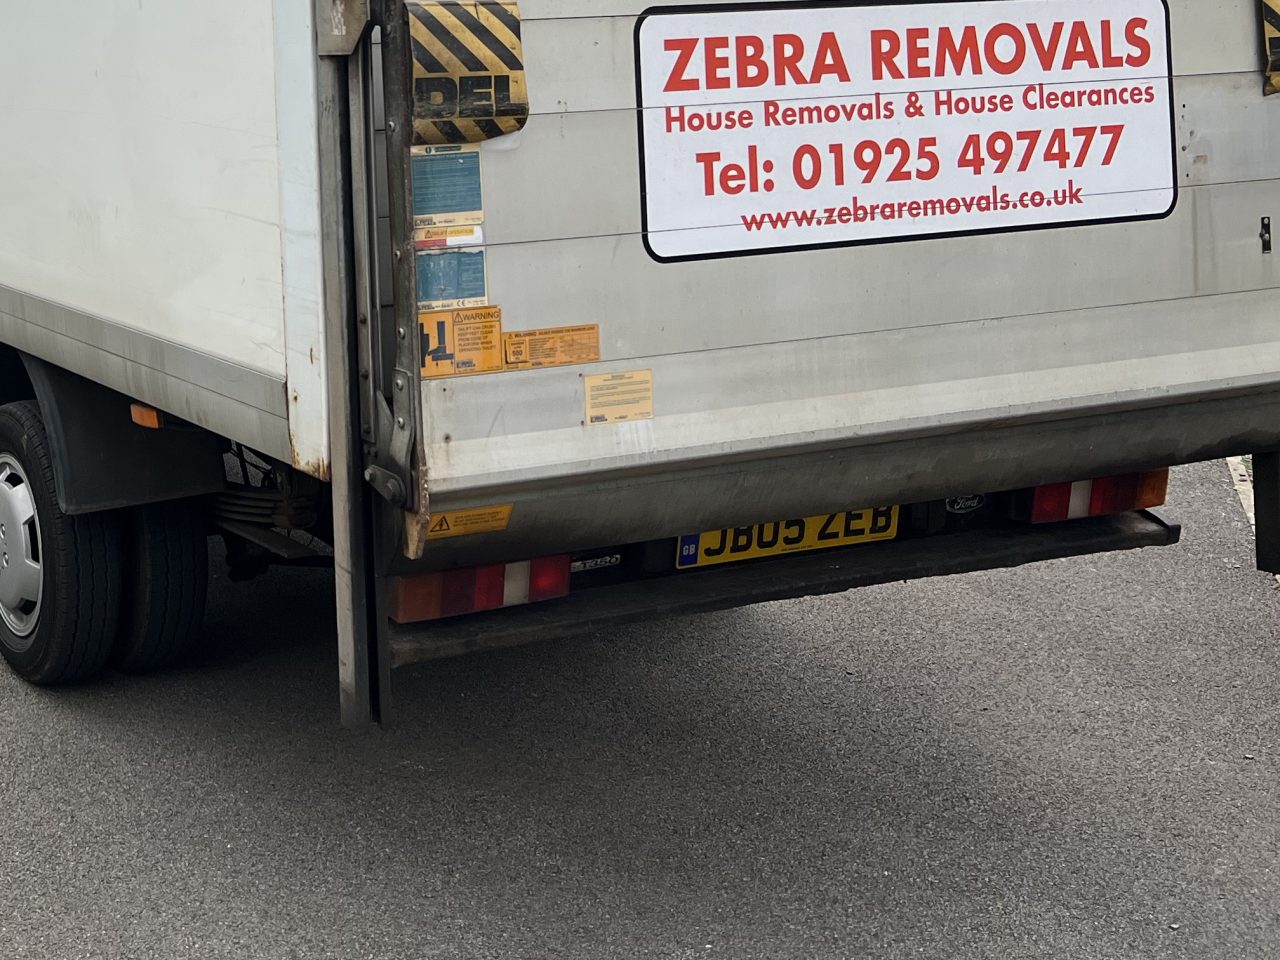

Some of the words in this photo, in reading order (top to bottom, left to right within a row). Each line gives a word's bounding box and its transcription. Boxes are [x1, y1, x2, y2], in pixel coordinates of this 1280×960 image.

[663, 32, 851, 92] ZEBRA
[869, 17, 1151, 82] REMOVALS
[414, 75, 528, 119] DEL
[664, 106, 754, 134] House
[763, 93, 895, 128] Removals
[904, 92, 924, 118] &
[934, 89, 1013, 116] House
[1021, 83, 1155, 112] Clearances
[695, 145, 775, 196] Tel:
[792, 137, 940, 190] 01925
[957, 124, 1125, 176] 497477
[740, 180, 1083, 233] www.zebraremovals.co.uk
[463, 311, 500, 321] WARNING
[682, 544, 696, 555] GB
